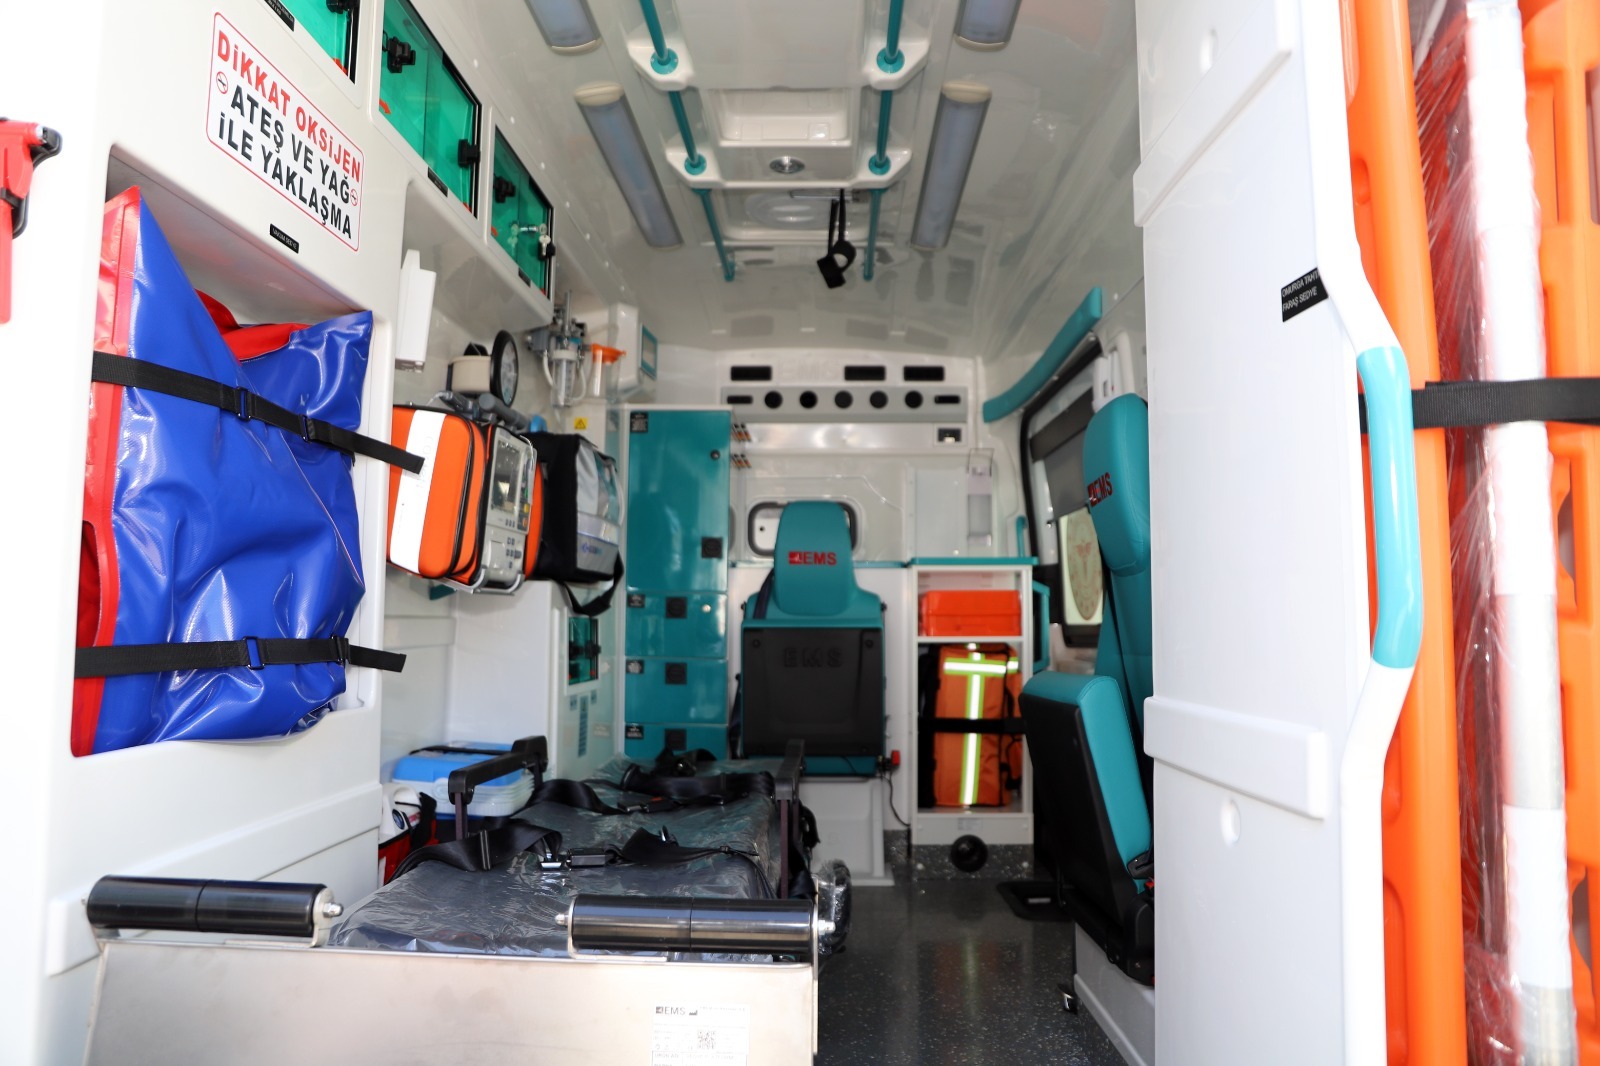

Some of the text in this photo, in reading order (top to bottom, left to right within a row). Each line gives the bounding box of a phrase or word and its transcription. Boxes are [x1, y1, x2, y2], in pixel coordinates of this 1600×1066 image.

[230, 85, 350, 204] ATEŞ VE YAĞ
[260, 145, 352, 239] YAKLAŞMA
[1299, 286, 1317, 303] SEDYE
[802, 551, 837, 566] EMS
[784, 647, 843, 668] EMS
[664, 1006, 686, 1016] EMS
